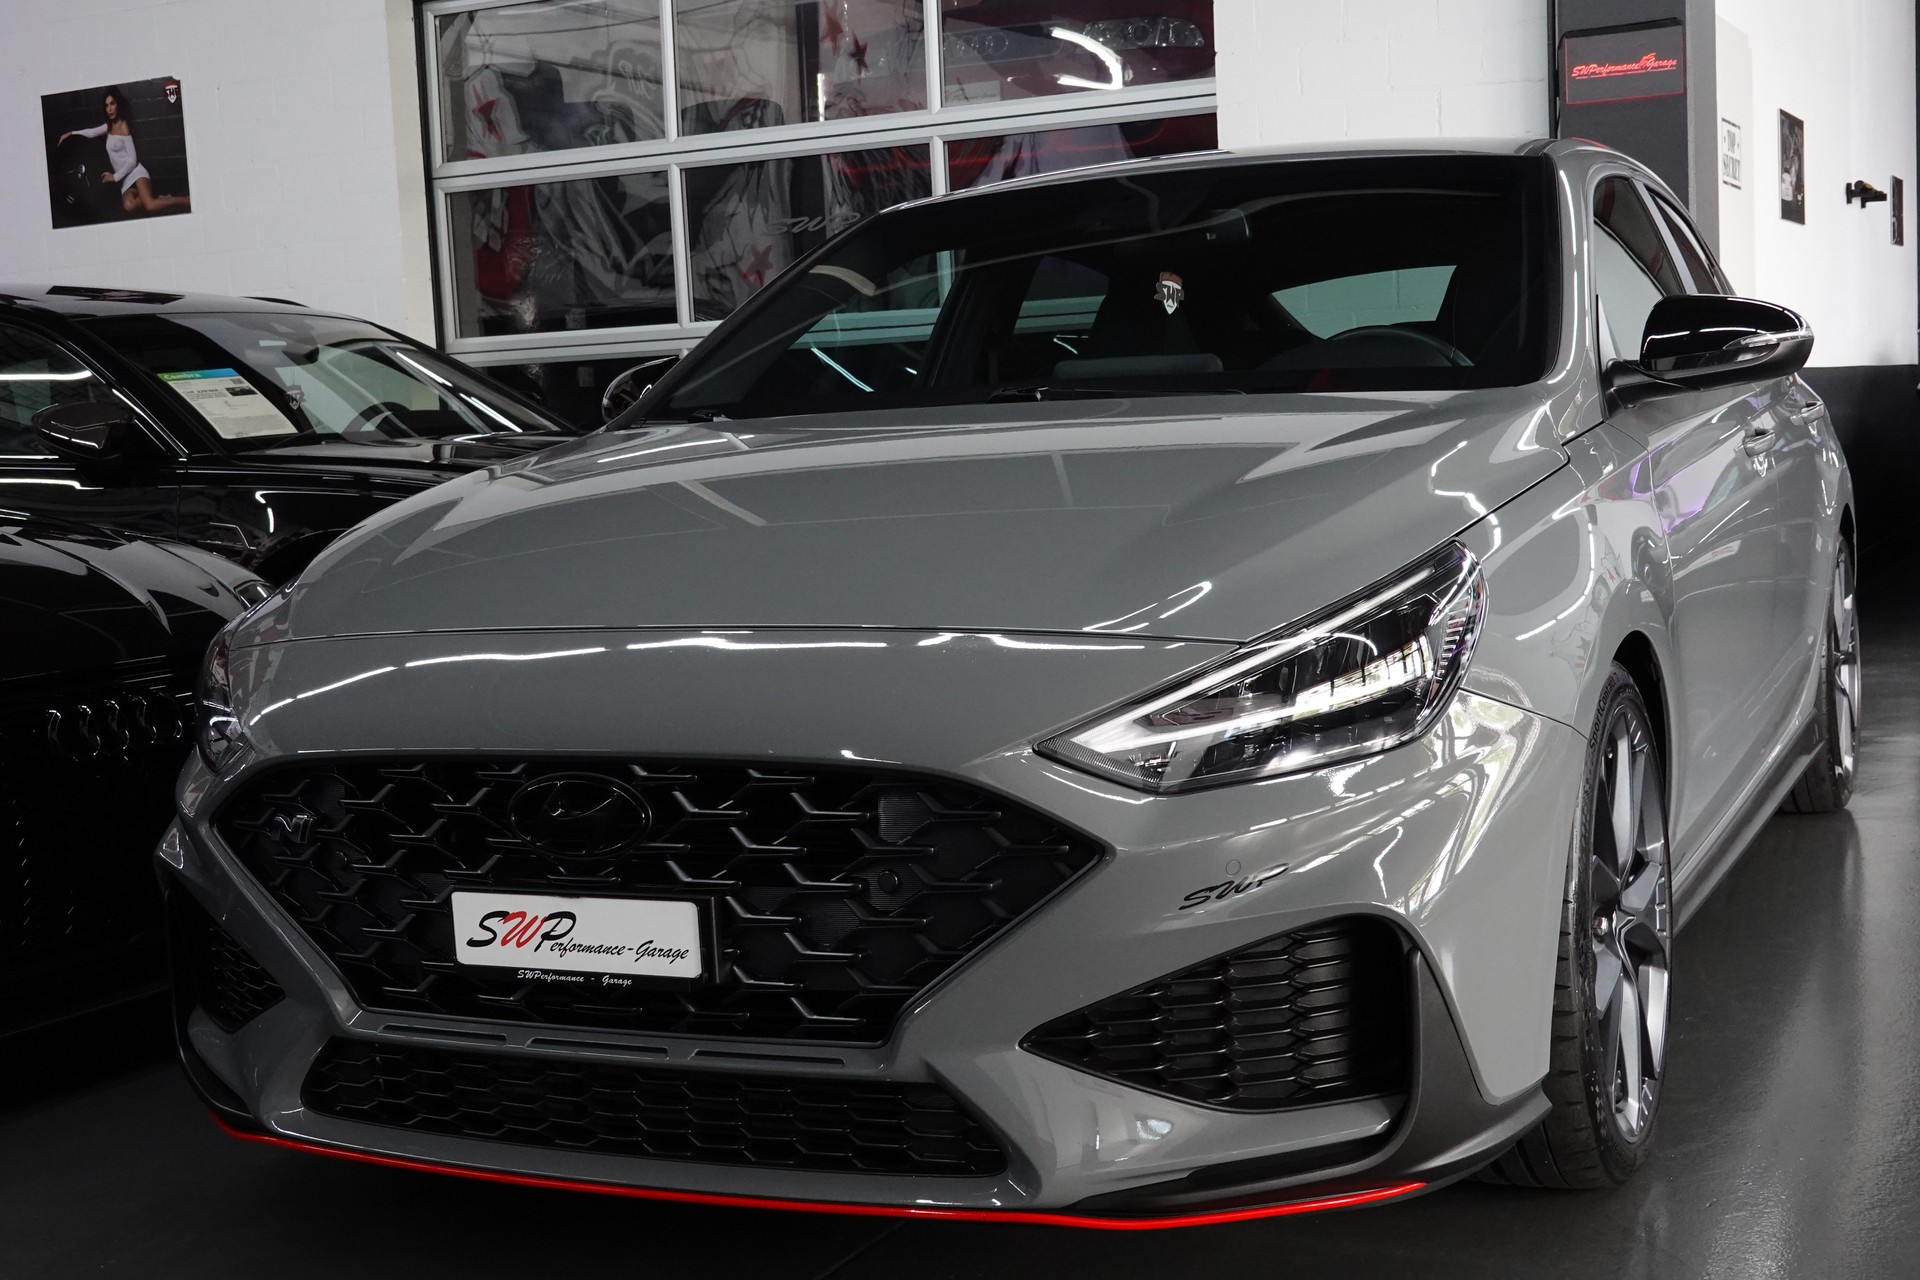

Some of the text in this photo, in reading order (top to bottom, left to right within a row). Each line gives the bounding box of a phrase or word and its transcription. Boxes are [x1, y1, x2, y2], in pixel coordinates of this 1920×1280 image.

[1645, 57, 1678, 71] Garage
[517, 969, 584, 983] SWPerformance
[601, 974, 633, 987] Garage
